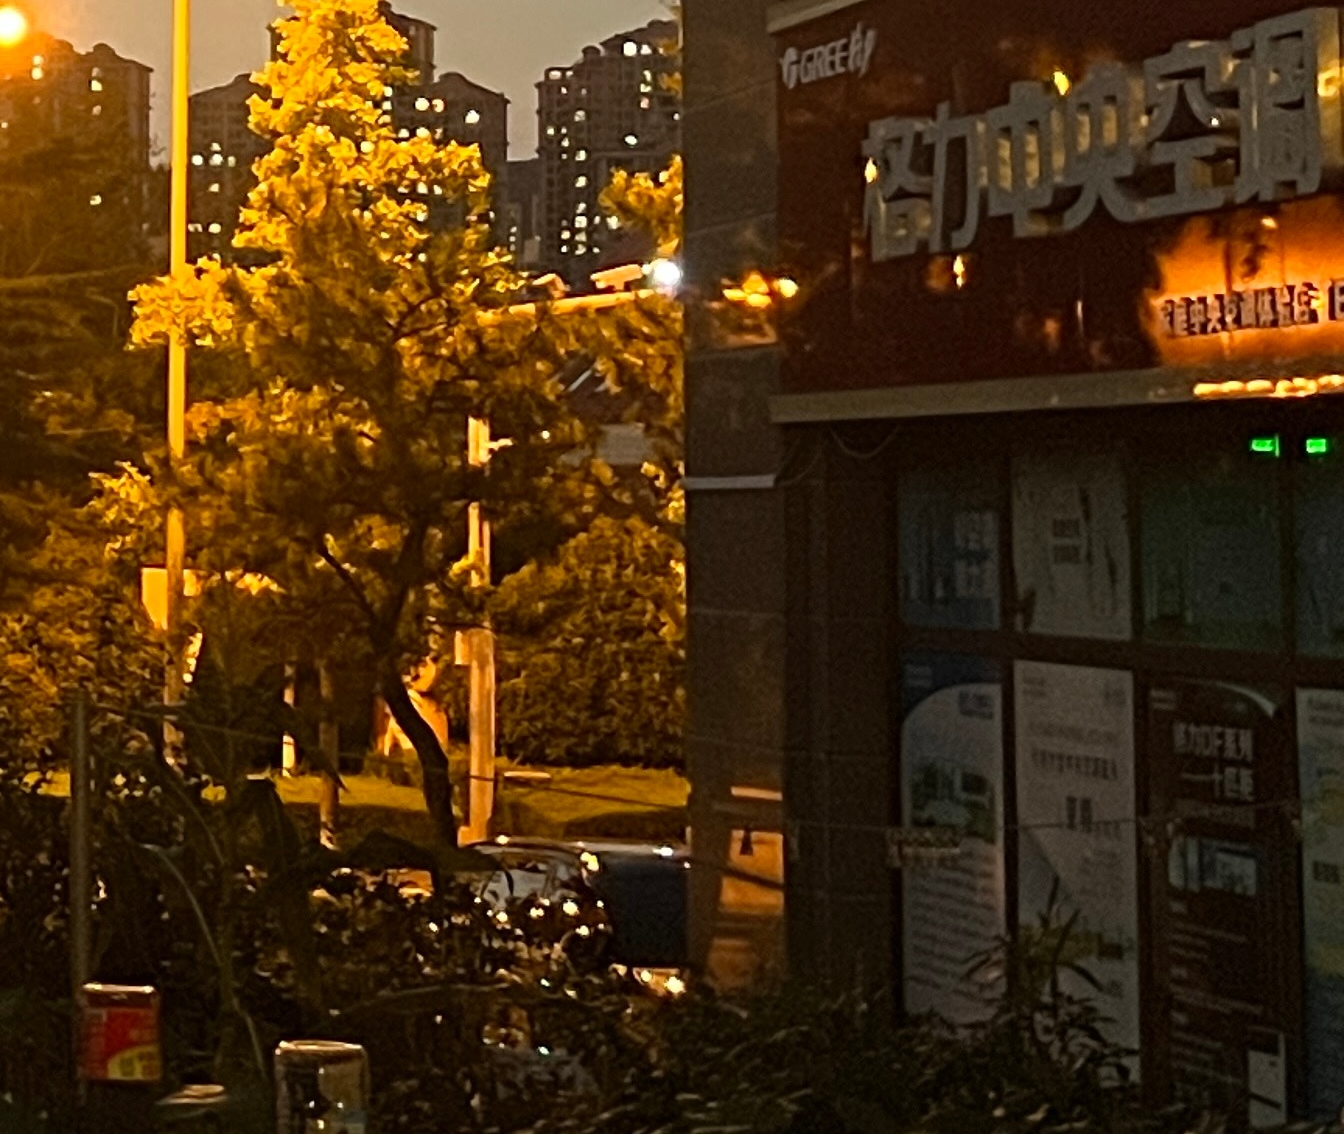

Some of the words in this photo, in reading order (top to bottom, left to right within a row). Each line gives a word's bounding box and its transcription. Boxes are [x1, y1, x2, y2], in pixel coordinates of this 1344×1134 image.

[862, 7, 1324, 262] 格力中央空调
